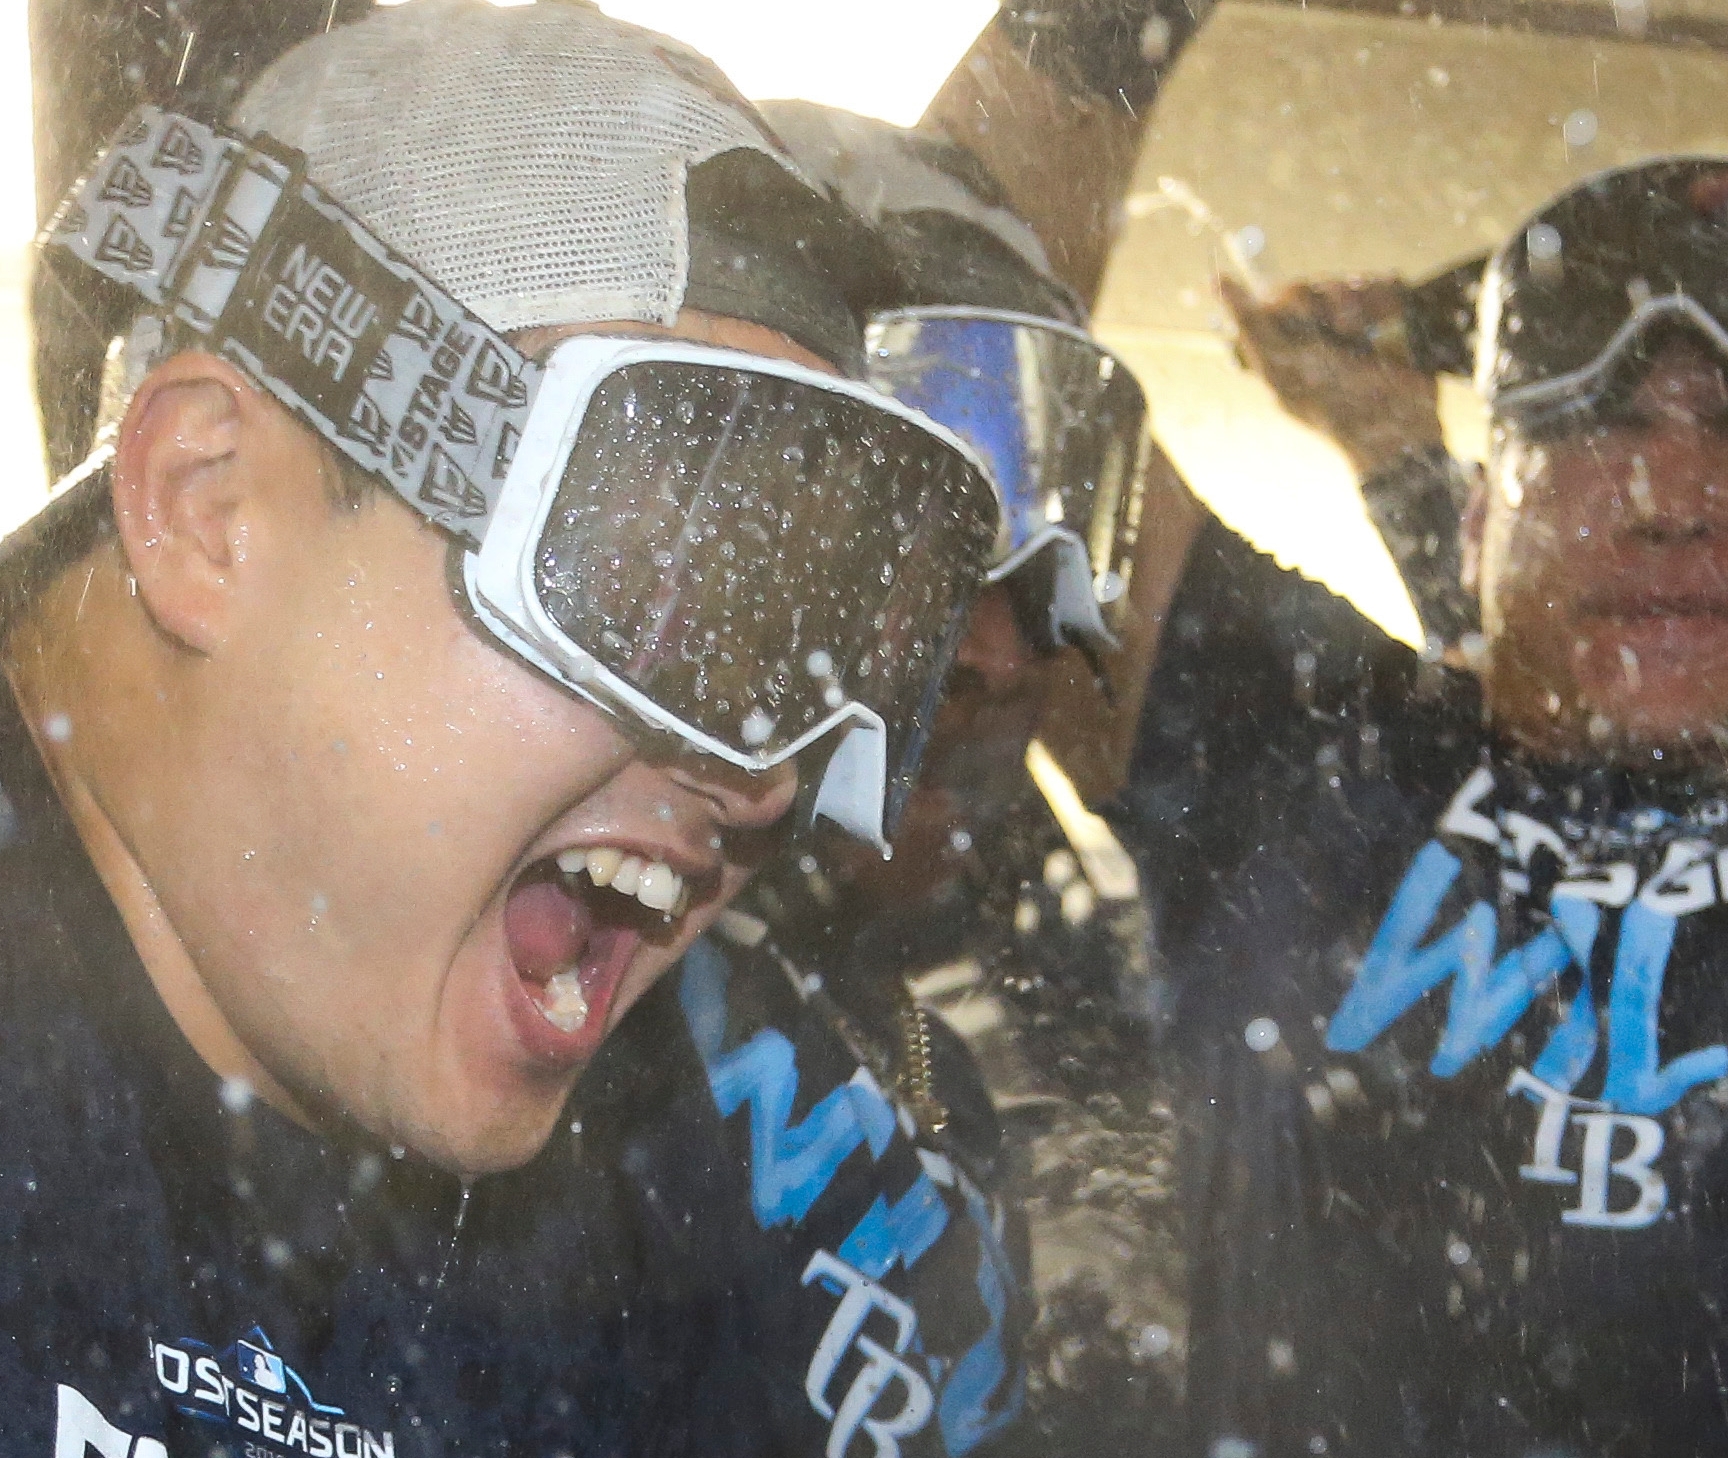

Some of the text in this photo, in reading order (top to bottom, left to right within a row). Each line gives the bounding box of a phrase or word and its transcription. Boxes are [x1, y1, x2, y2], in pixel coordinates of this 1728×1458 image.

[264, 283, 355, 383] ERA
[280, 243, 378, 339] NEW
[1506, 1067, 1669, 1230] TB
